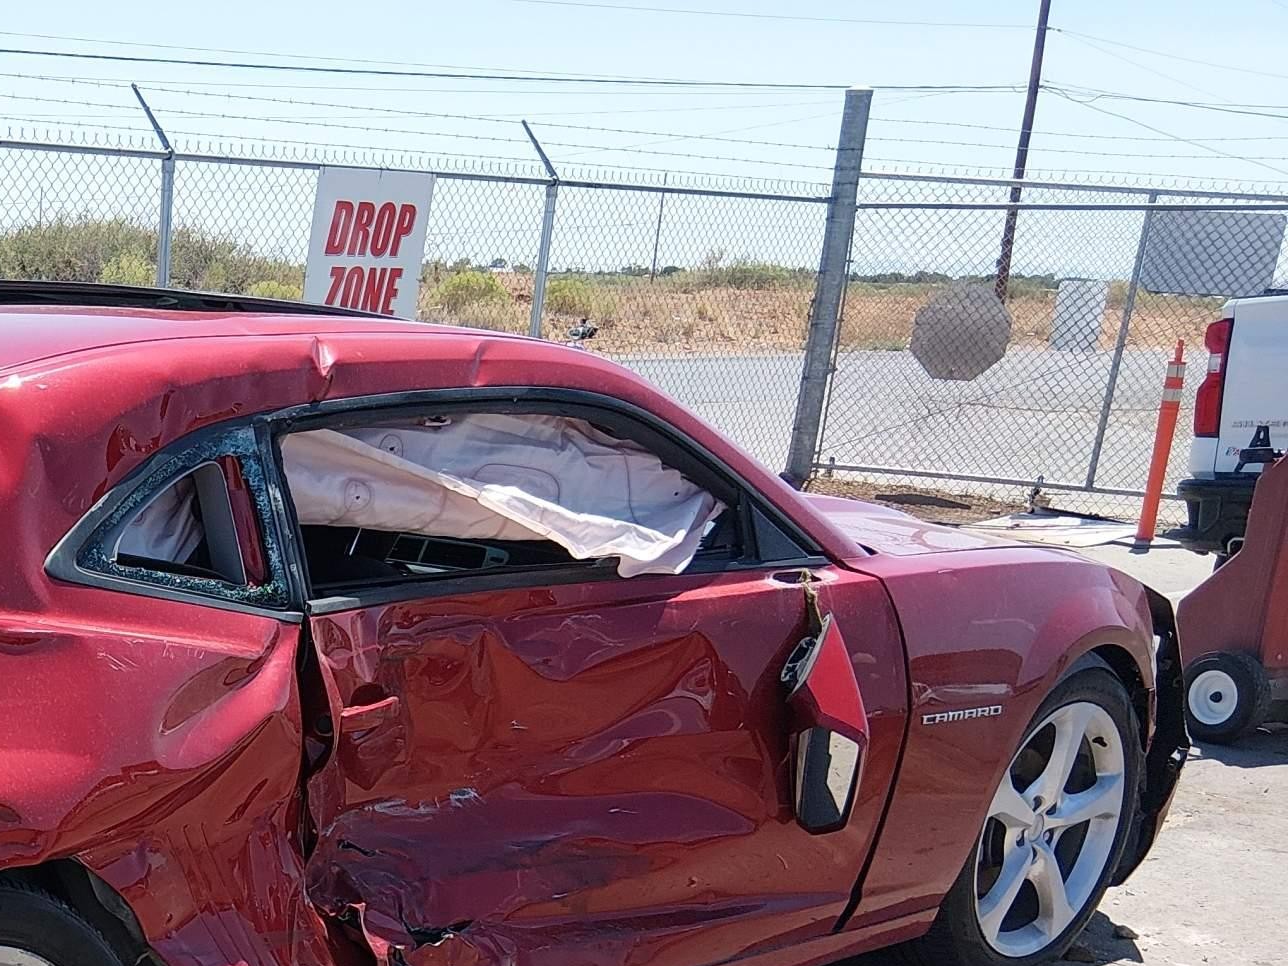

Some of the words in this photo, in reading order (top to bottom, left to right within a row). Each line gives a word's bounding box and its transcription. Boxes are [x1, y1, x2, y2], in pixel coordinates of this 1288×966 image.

[324, 200, 417, 258] DROP
[324, 266, 403, 315] ZONE
[922, 705, 1002, 725] CAMARO
